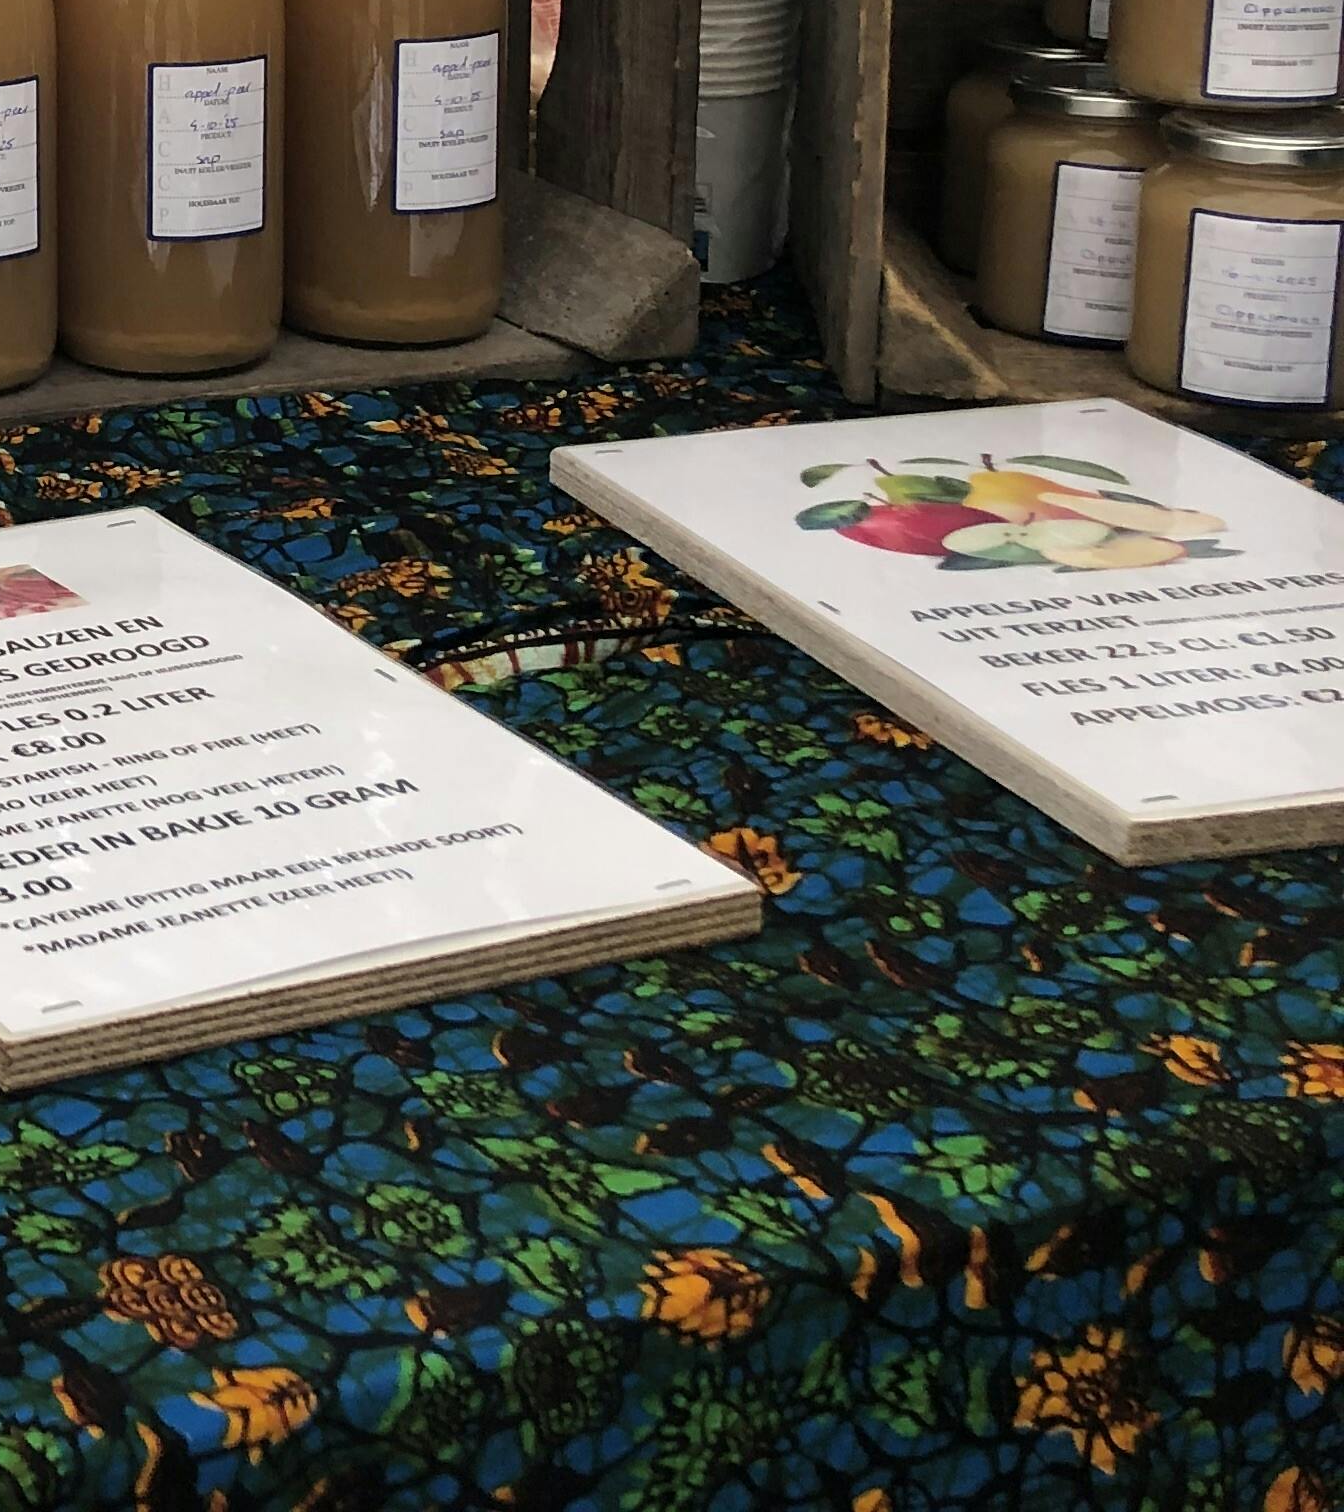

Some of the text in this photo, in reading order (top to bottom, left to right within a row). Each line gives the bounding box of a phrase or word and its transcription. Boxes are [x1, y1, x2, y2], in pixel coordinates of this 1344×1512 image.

[910, 596, 1072, 623] APPELSAP
[1076, 590, 1160, 606] VAN
[1159, 580, 1267, 600] EIGEN
[115, 616, 164, 634] EN
[938, 615, 1140, 643] UIT TERZIET
[24, 635, 210, 677] GEDROOGD
[980, 626, 1336, 668] BEKER 22.5 CL: €1.50
[1022, 656, 1344, 696] FLES 1 LITER: €4.00
[63, 702, 121, 721] 0.2
[120, 687, 215, 711] LITER
[1070, 694, 1302, 726] APPELMOES:
[11, 731, 106, 757] €8.00
[112, 750, 168, 767] RING
[171, 744, 198, 756] OF
[202, 736, 248, 752] FIRE
[250, 723, 321, 745] (HEET)
[29, 786, 89, 807] (ZEER
[91, 774, 157, 794] HEET)
[35, 800, 141, 829] JEANETTE
[142, 790, 203, 811] (NOG
[202, 780, 260, 798] VEEL
[90, 831, 137, 852] IN
[138, 810, 253, 841] BAKJE
[254, 800, 301, 820] 10
[304, 778, 420, 810] GRAM
[124, 883, 209, 909] (PITTIG
[209, 867, 285, 892] MAAR
[284, 857, 332, 876] EEN
[332, 838, 437, 865] BEKENDE
[435, 822, 524, 846] SOORT)
[154, 895, 268, 929] JEANETTE
[267, 883, 336, 905] (ZEER
